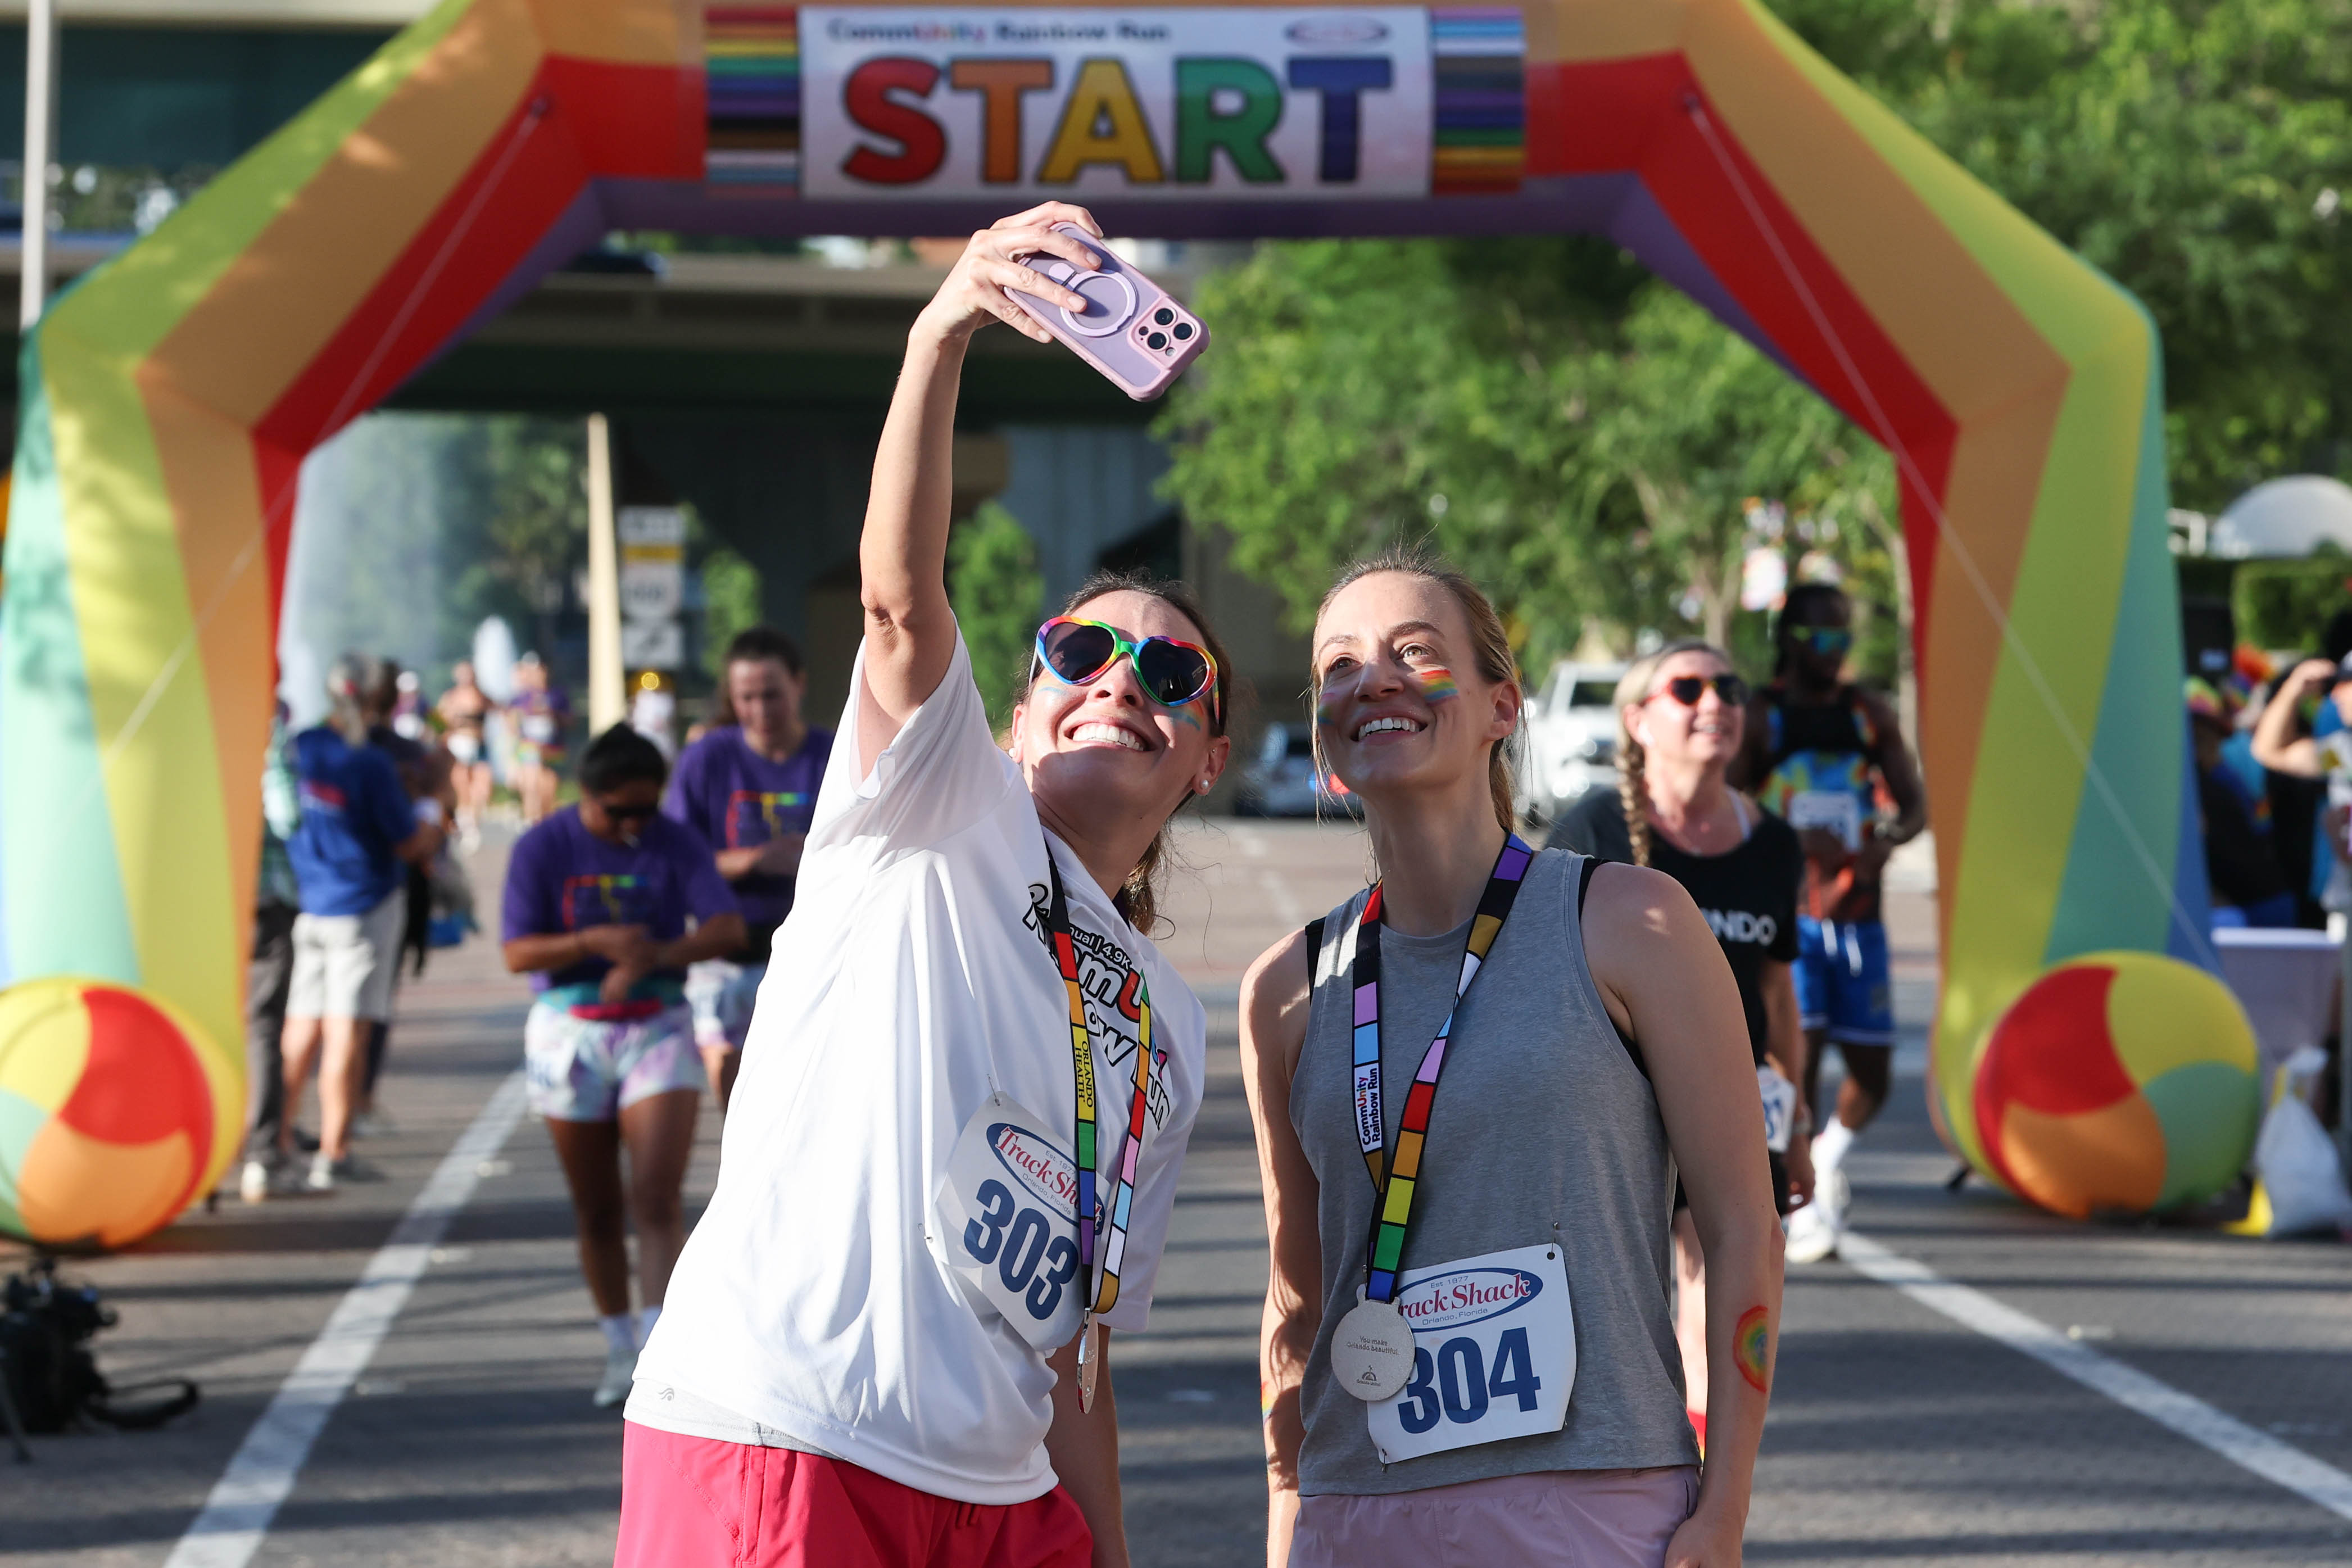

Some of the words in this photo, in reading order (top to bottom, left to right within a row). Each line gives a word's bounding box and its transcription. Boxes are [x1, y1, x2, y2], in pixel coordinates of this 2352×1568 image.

[1117, 21, 1171, 40] Run
[842, 55, 1393, 185] START
[1102, 945, 1132, 971] 4.9K
[1075, 1047, 1085, 1099] HEALTH
[1081, 1041, 1093, 1108] ORLANDO
[1368, 1068, 1377, 1090] Run
[1357, 1077, 1371, 1145] CommUnity
[1369, 1092, 1380, 1142] Rainbow
[995, 1126, 1053, 1184] Track
[1050, 1195, 1072, 1216] Florida
[963, 1179, 1079, 1321] 303
[1398, 1289, 1448, 1318] rack
[1451, 1273, 1530, 1310] Shack
[1448, 1276, 1469, 1285] 1977
[1458, 1308, 1488, 1318] Florida
[1347, 1341, 1370, 1351] Orlando
[1397, 1326, 1542, 1434] 304
